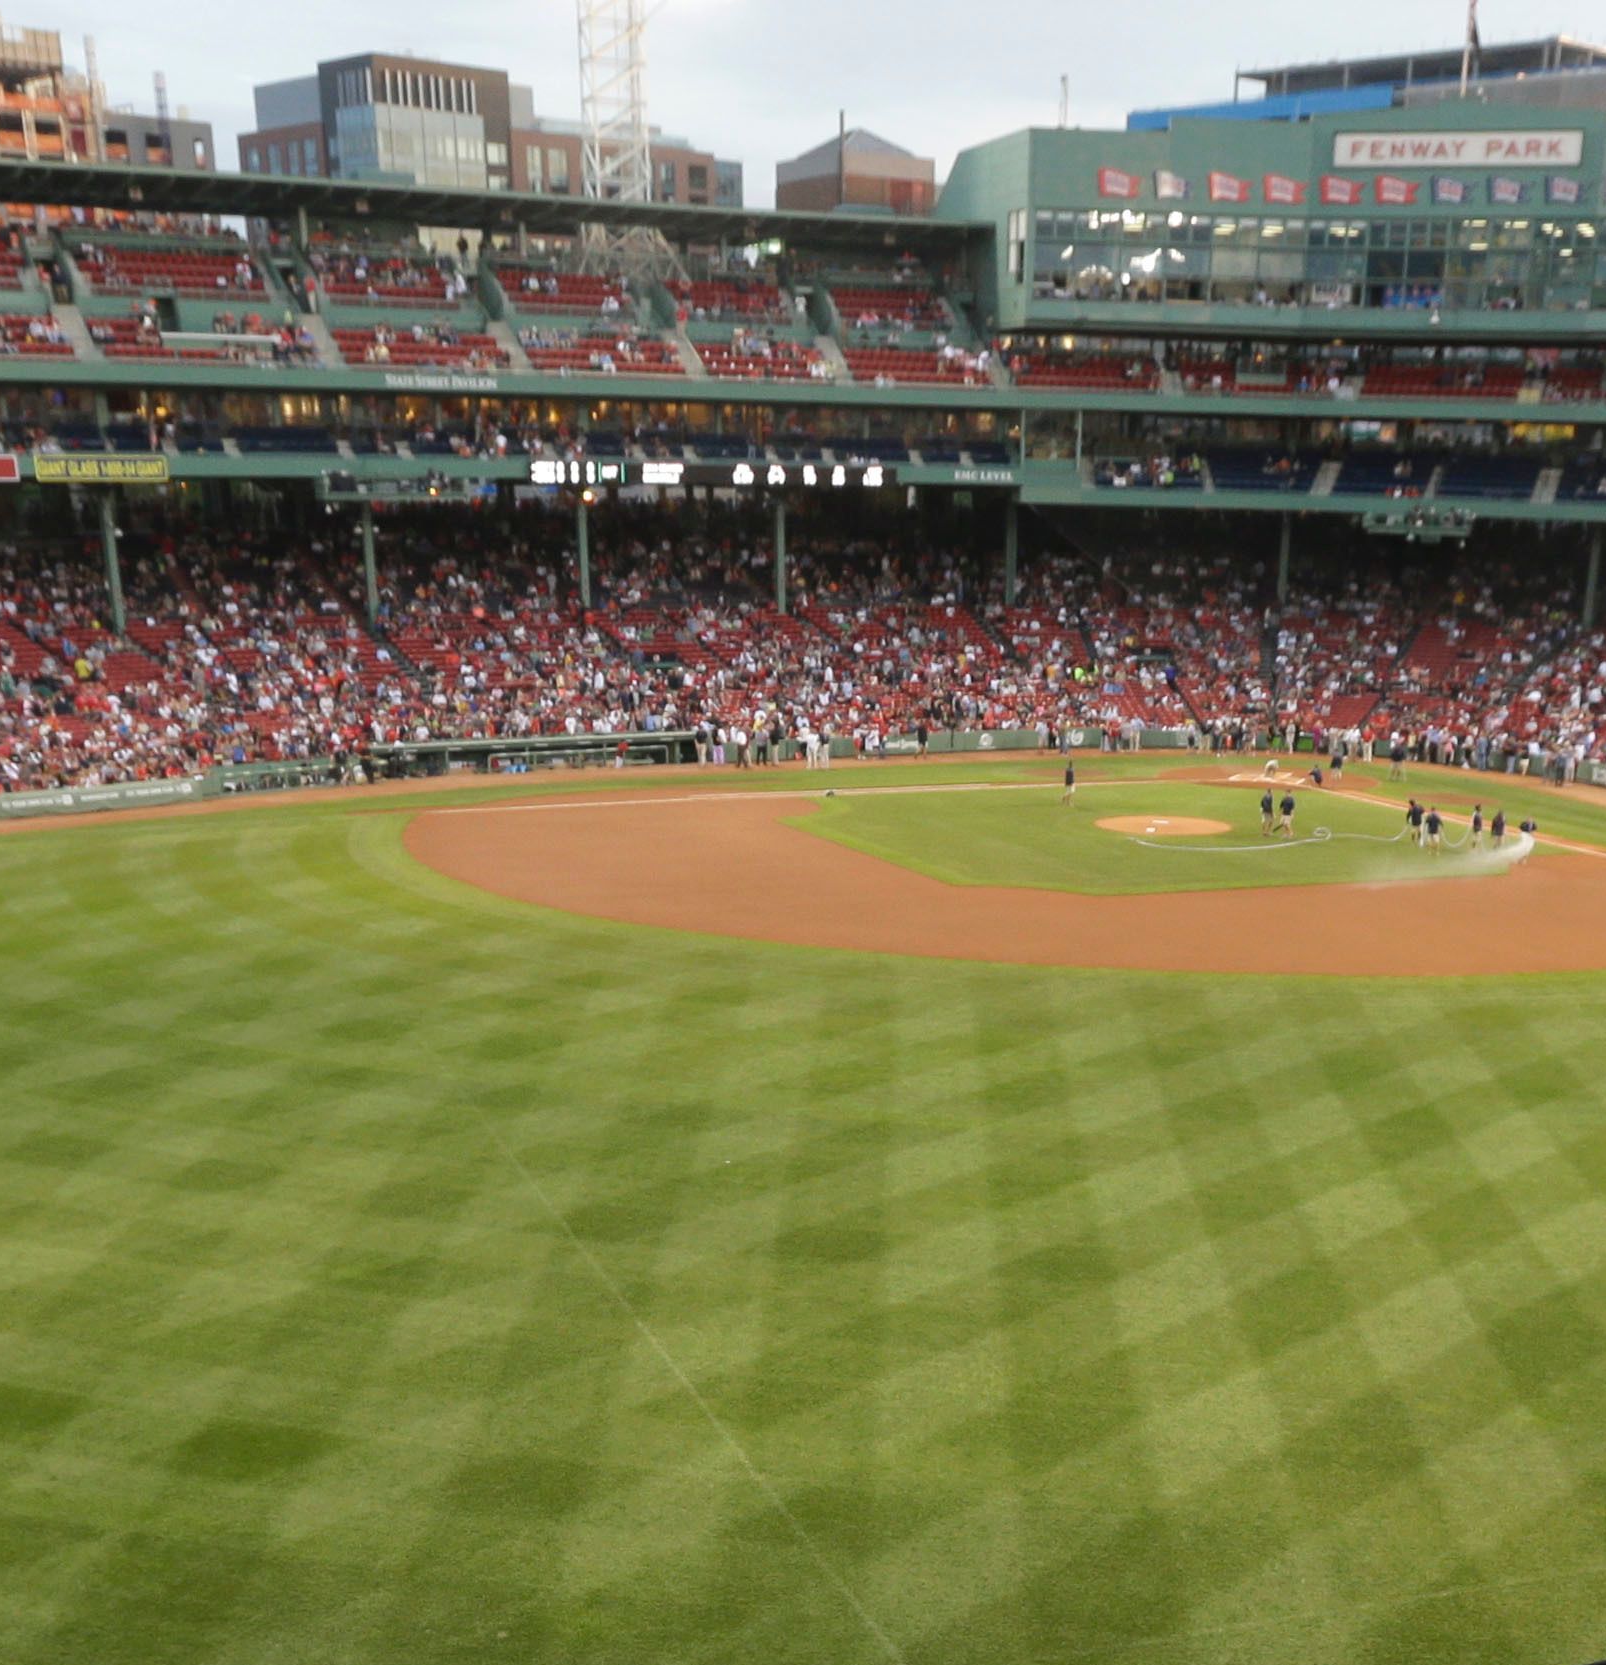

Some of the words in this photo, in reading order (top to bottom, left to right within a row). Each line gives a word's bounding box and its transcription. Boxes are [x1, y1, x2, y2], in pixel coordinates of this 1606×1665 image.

[1350, 140, 1465, 160] FENWAY
[1486, 138, 1563, 158] PARK
[979, 471, 1014, 482] LEVEL
